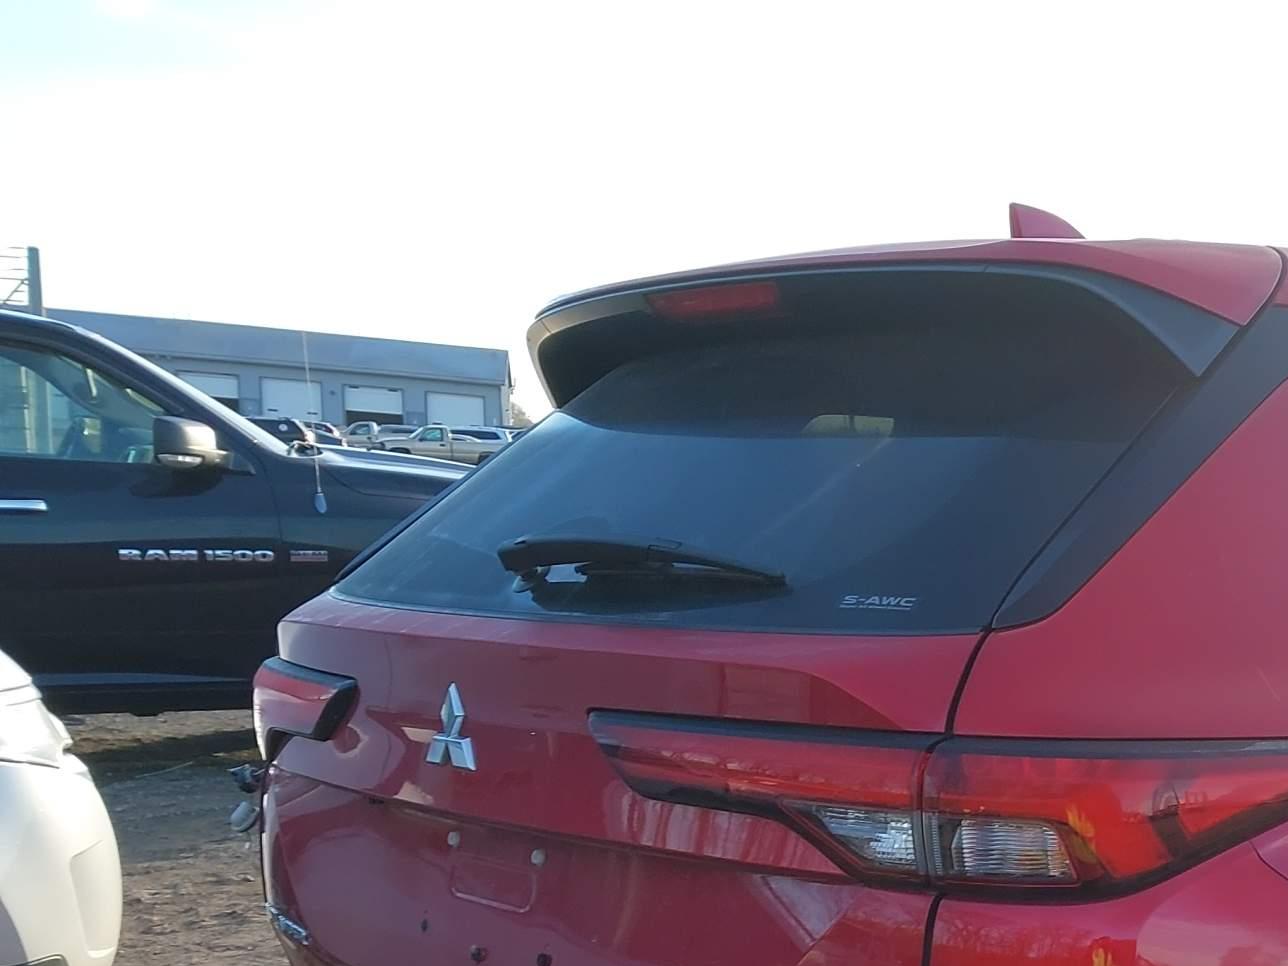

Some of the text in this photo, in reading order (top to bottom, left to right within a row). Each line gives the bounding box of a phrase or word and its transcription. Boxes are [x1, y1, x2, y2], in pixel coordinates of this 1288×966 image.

[118, 549, 275, 562] RAM 1500
[842, 595, 917, 607] S-AWC
